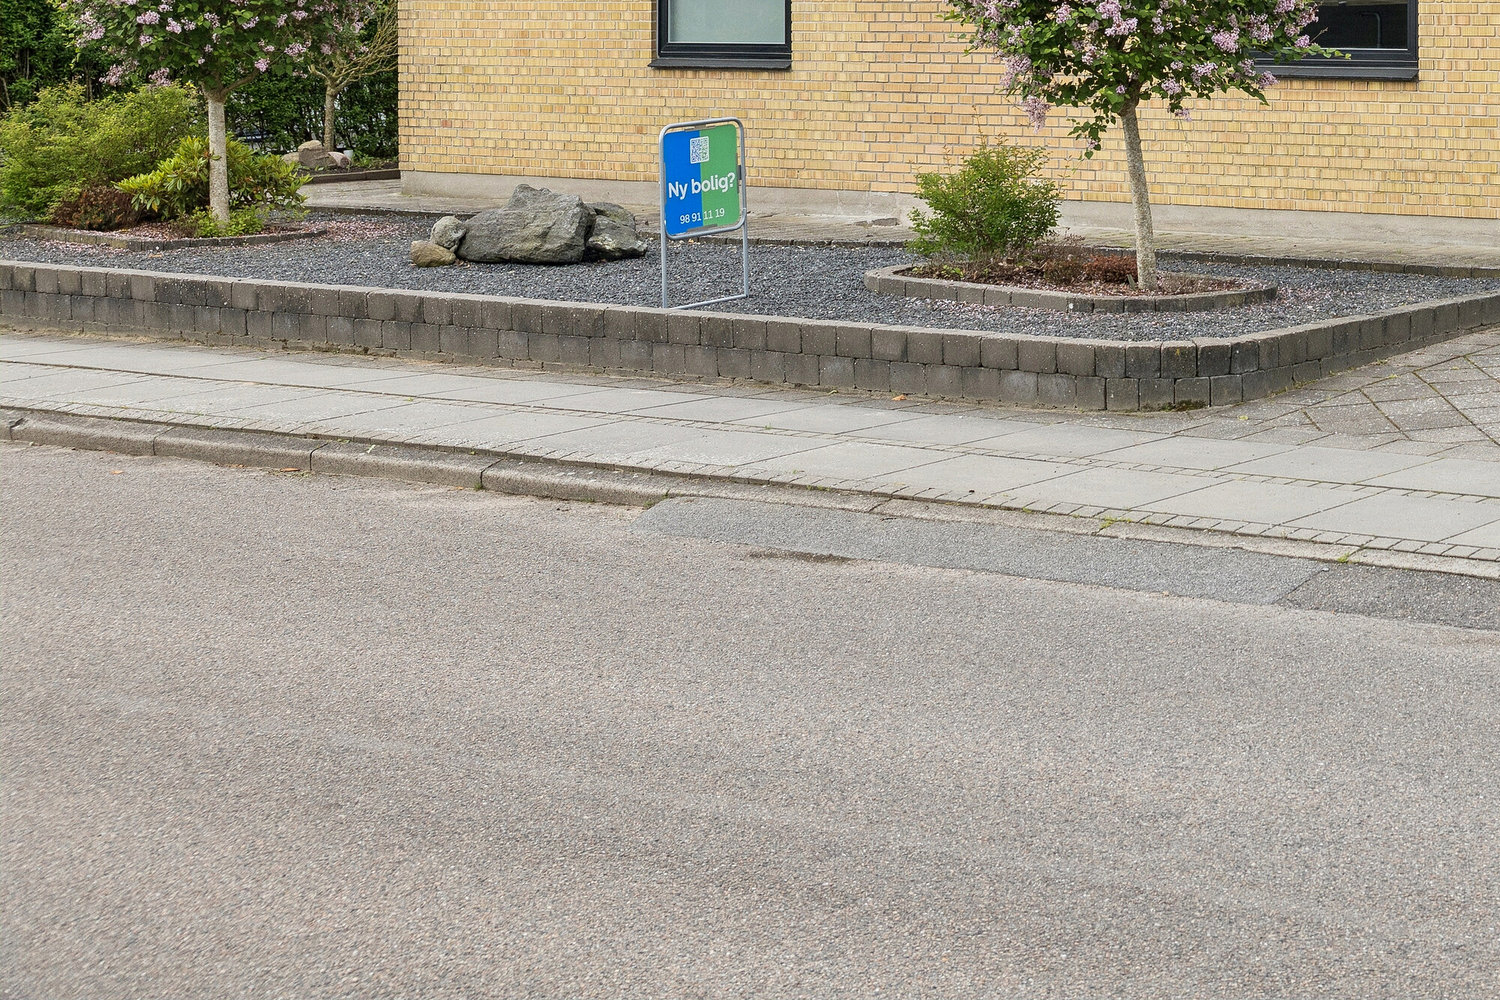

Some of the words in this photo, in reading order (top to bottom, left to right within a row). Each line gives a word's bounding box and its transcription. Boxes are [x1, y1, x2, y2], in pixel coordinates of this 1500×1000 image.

[668, 181, 688, 200] Ny
[691, 172, 735, 194] bolig?
[680, 214, 690, 224] 98
[691, 212, 701, 222] 91
[704, 210, 713, 220] 11
[715, 207, 725, 218] 19
